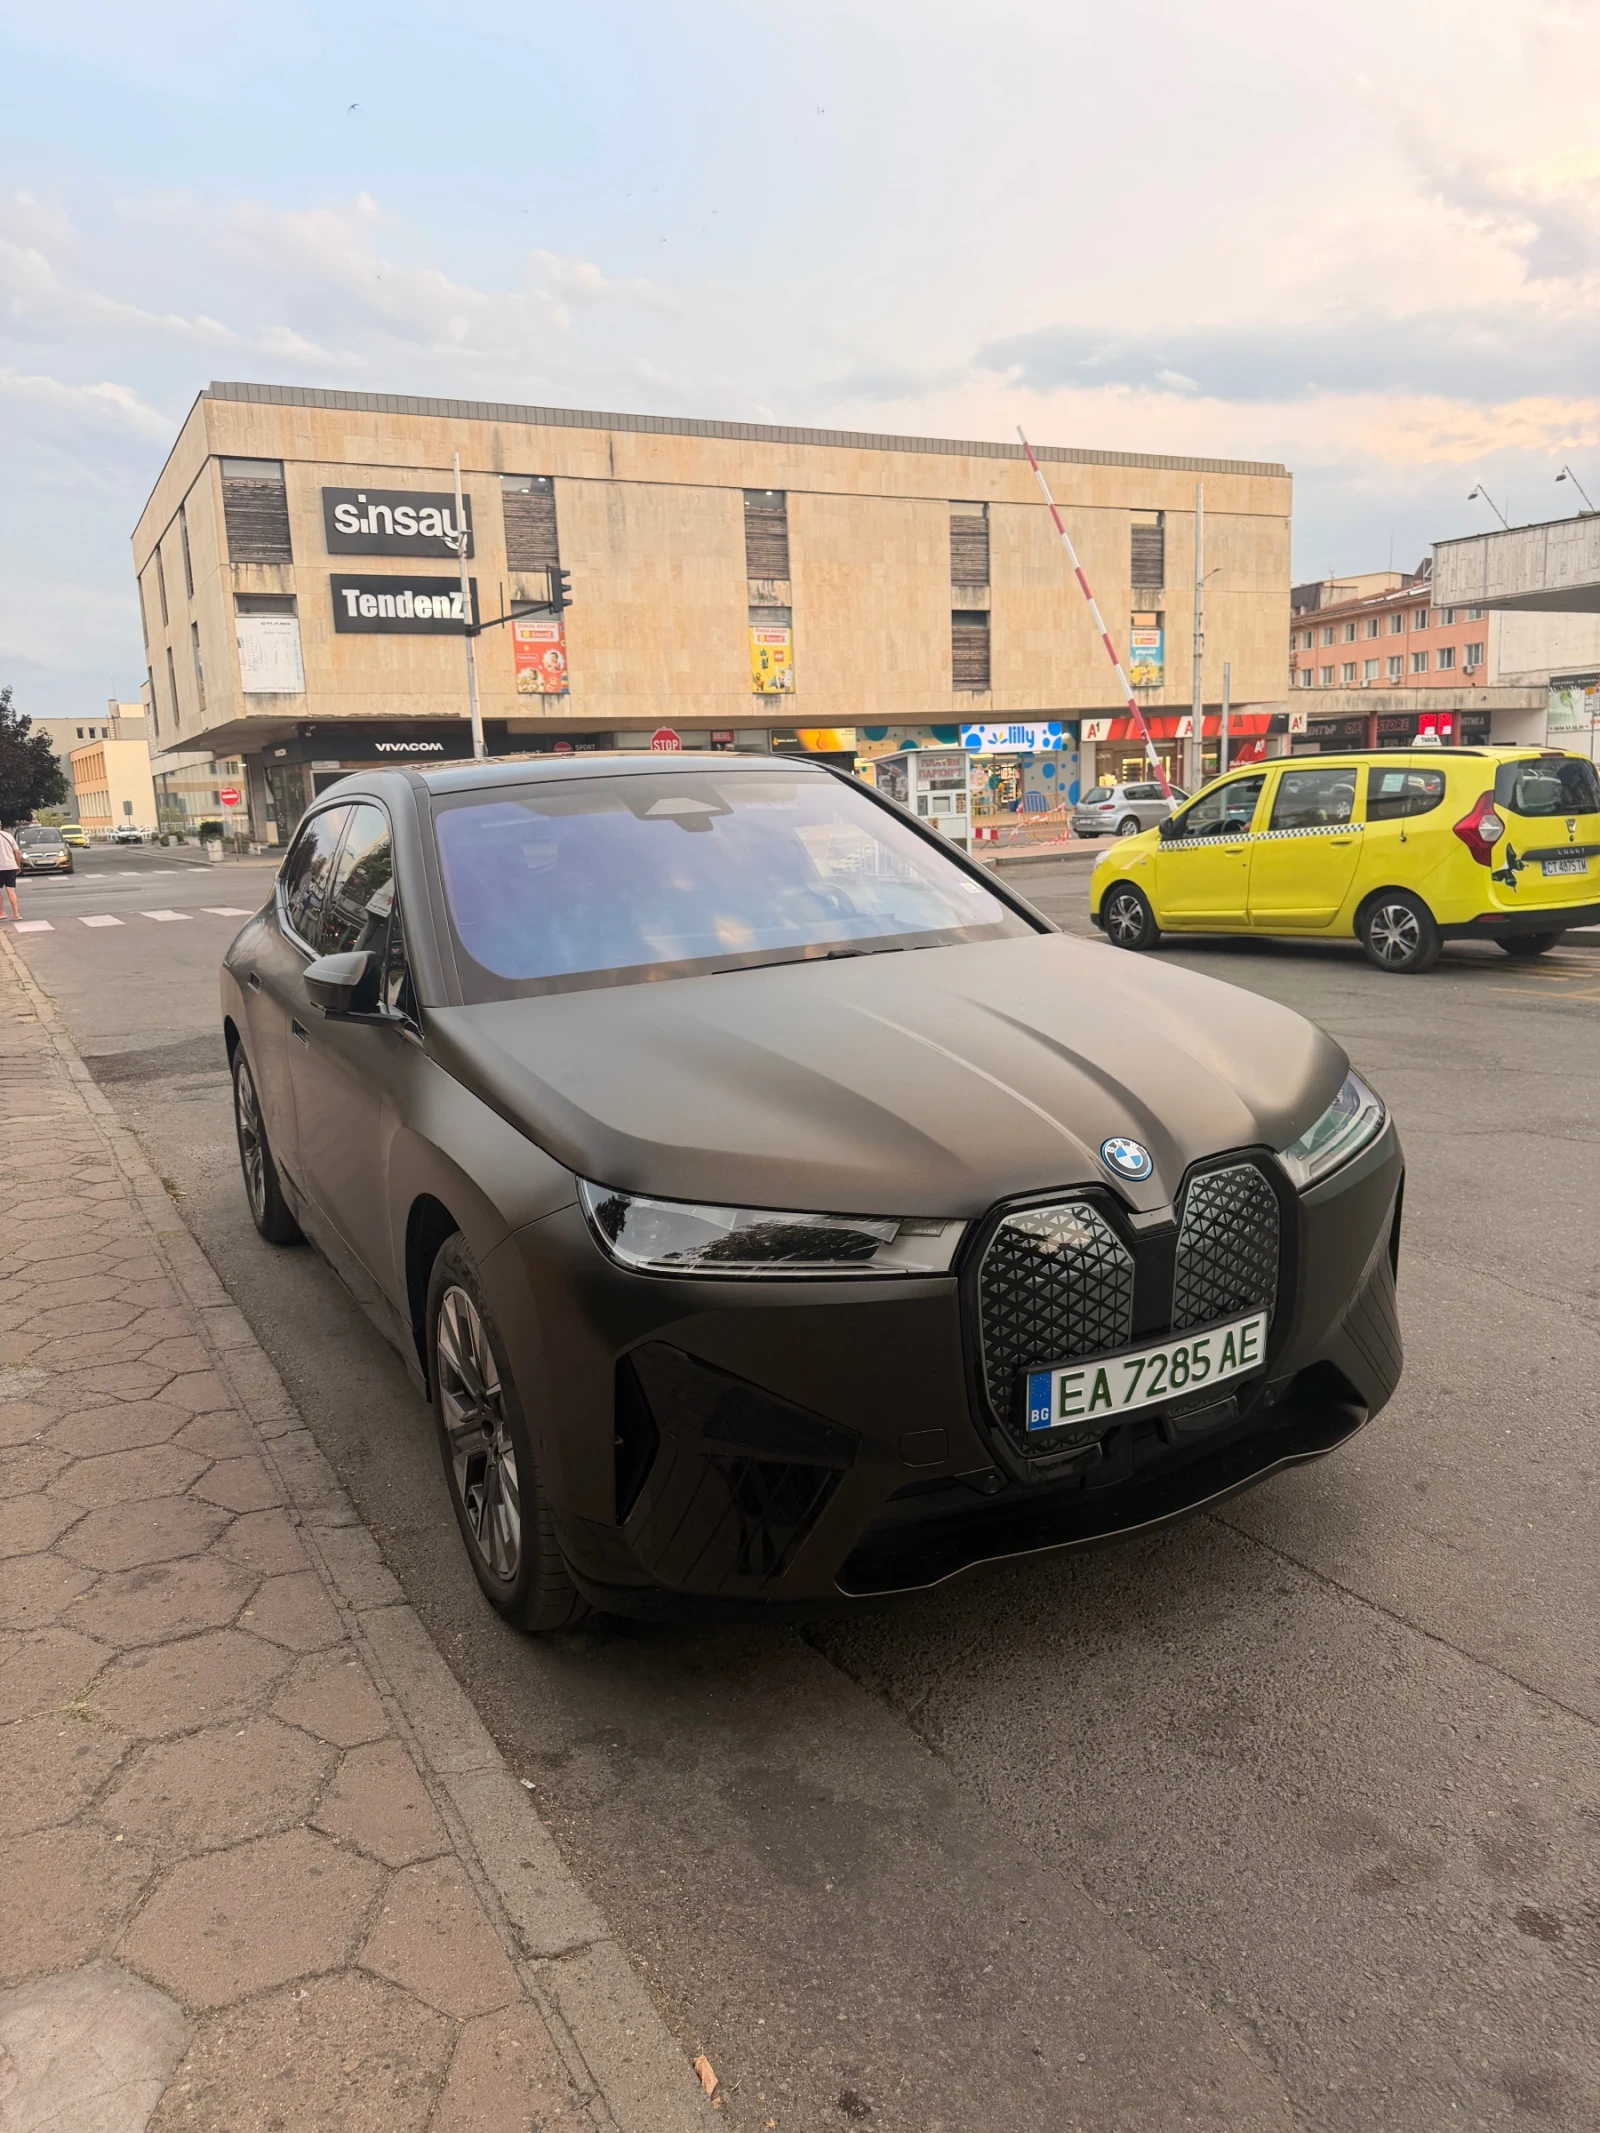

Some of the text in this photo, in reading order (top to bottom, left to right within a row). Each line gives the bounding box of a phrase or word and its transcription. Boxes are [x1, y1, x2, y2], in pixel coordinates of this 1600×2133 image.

[334, 494, 467, 549] sinsay
[1087, 721, 1100, 739] A1
[1291, 716, 1302, 730] A1
[1305, 724, 1337, 737] ЕНТЪР
[1377, 718, 1410, 732] STORE
[1008, 725, 1035, 748] lilly
[375, 742, 444, 751] VIVACOM
[653, 739, 679, 750] STOP
[1106, 1139, 1140, 1154] BMW
[1059, 1319, 1261, 1418] EA 7285 AE
[1031, 1407, 1049, 1422] BG
